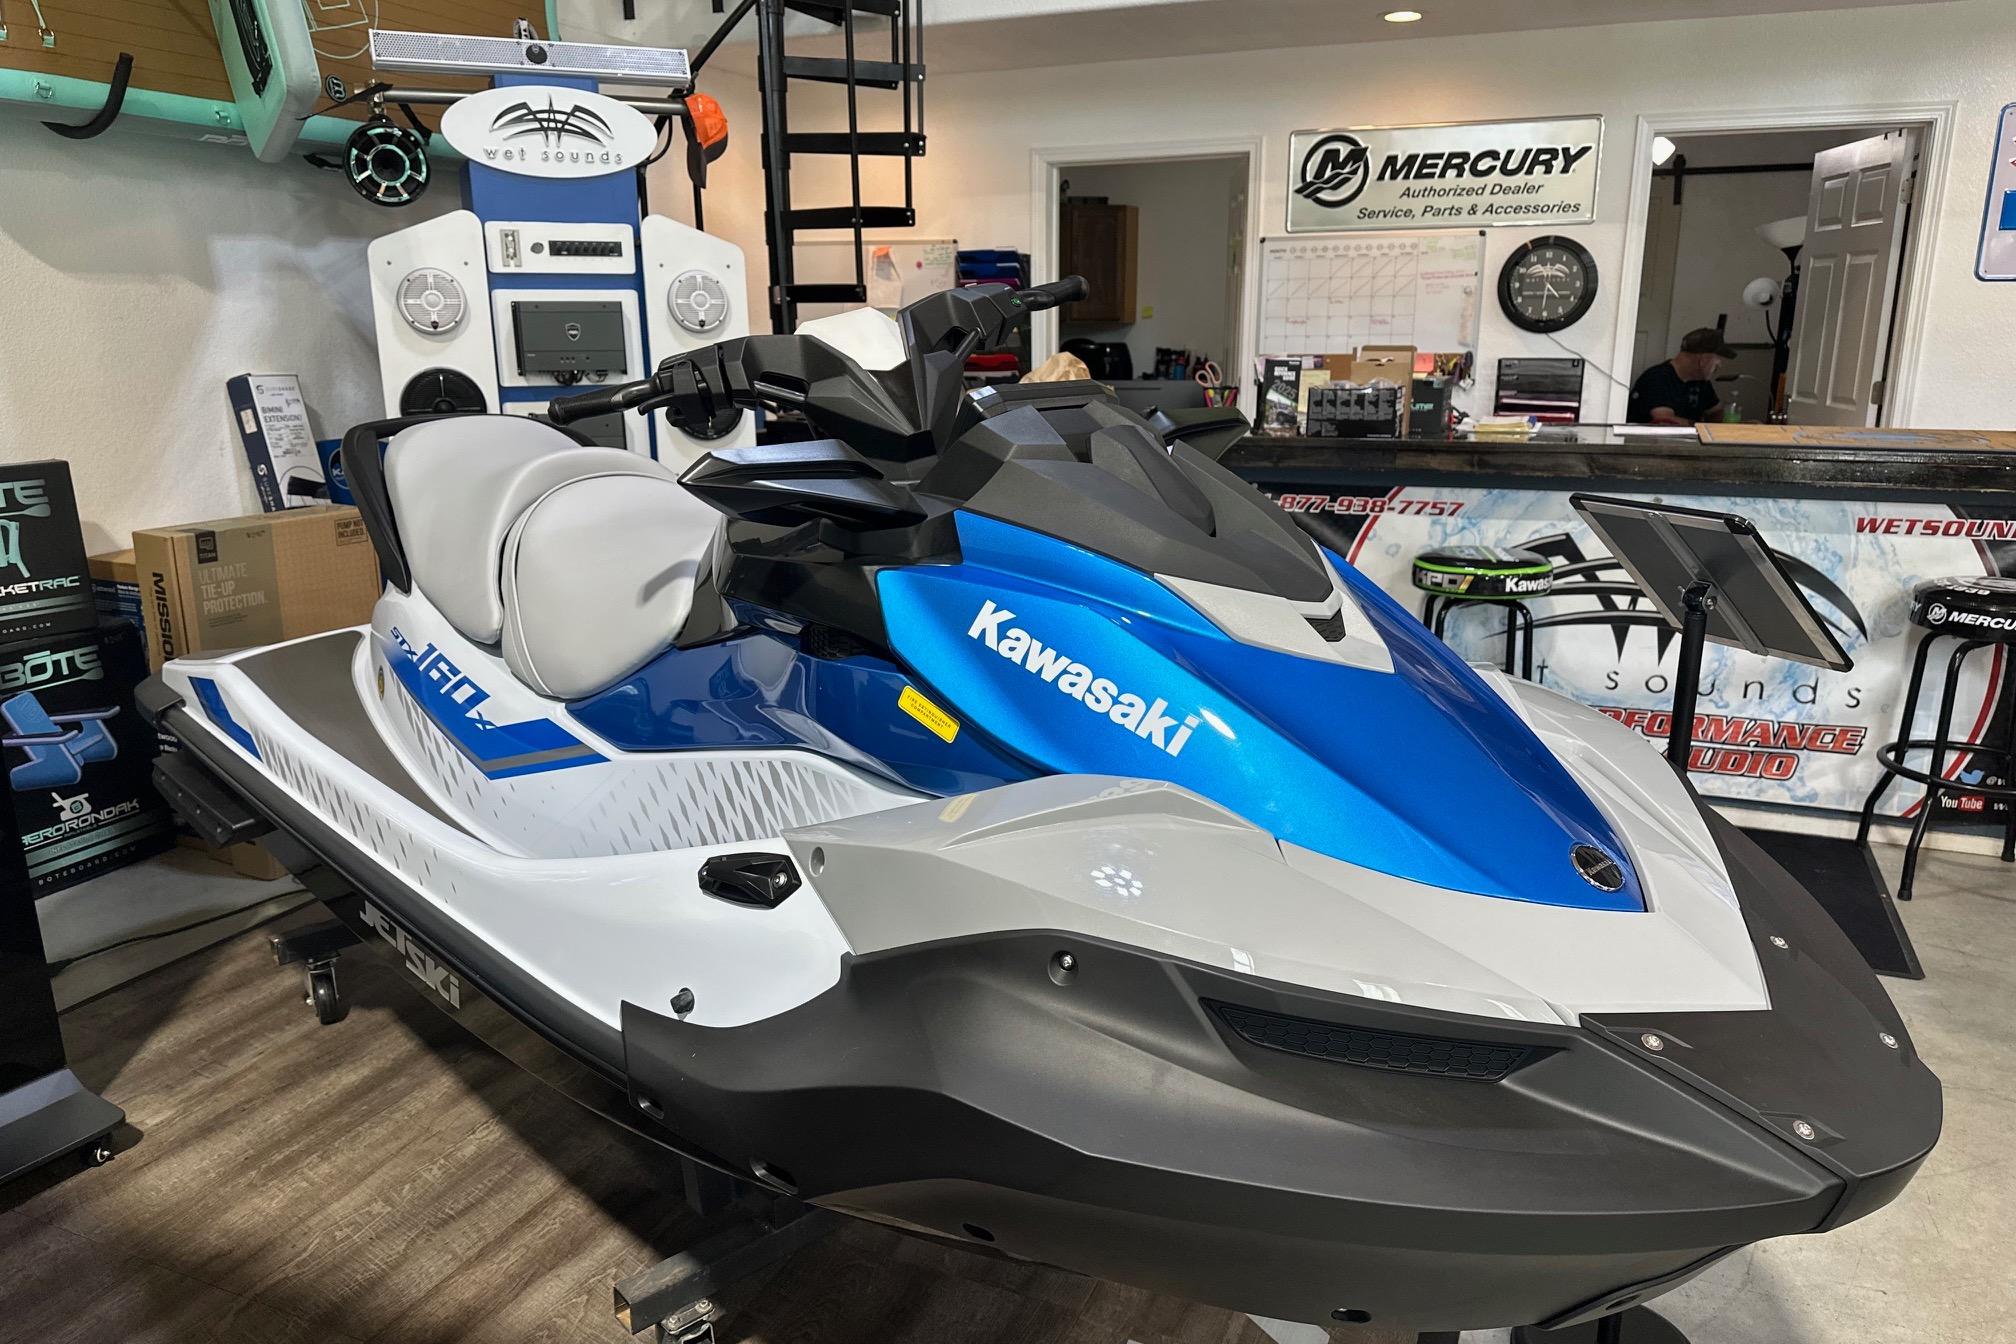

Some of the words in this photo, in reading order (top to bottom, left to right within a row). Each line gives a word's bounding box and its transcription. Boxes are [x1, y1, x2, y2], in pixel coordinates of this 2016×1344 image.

[484, 147, 526, 161] wet
[542, 148, 623, 163] sounds
[1376, 146, 1592, 181] MERCURY
[1400, 185, 1486, 200] Authorized
[1490, 182, 1544, 197] Dealer
[1357, 206, 1416, 220] Service,
[1421, 204, 1462, 218] Parts
[1467, 203, 1478, 216] &
[1483, 201, 1581, 217] Accessories
[1272, 379, 1297, 400] 2025
[1856, 517, 2016, 539] WETSOUN
[199, 562, 247, 584] ULTIMATE
[0, 576, 80, 597] KETRAC
[201, 580, 236, 600] TIE-UP
[1505, 576, 1552, 593] Kawas
[152, 571, 175, 661] MISSIO
[968, 599, 1200, 757] Kawasaki
[1605, 669, 1861, 709] sounds
[1672, 747, 1799, 780] UDIO
